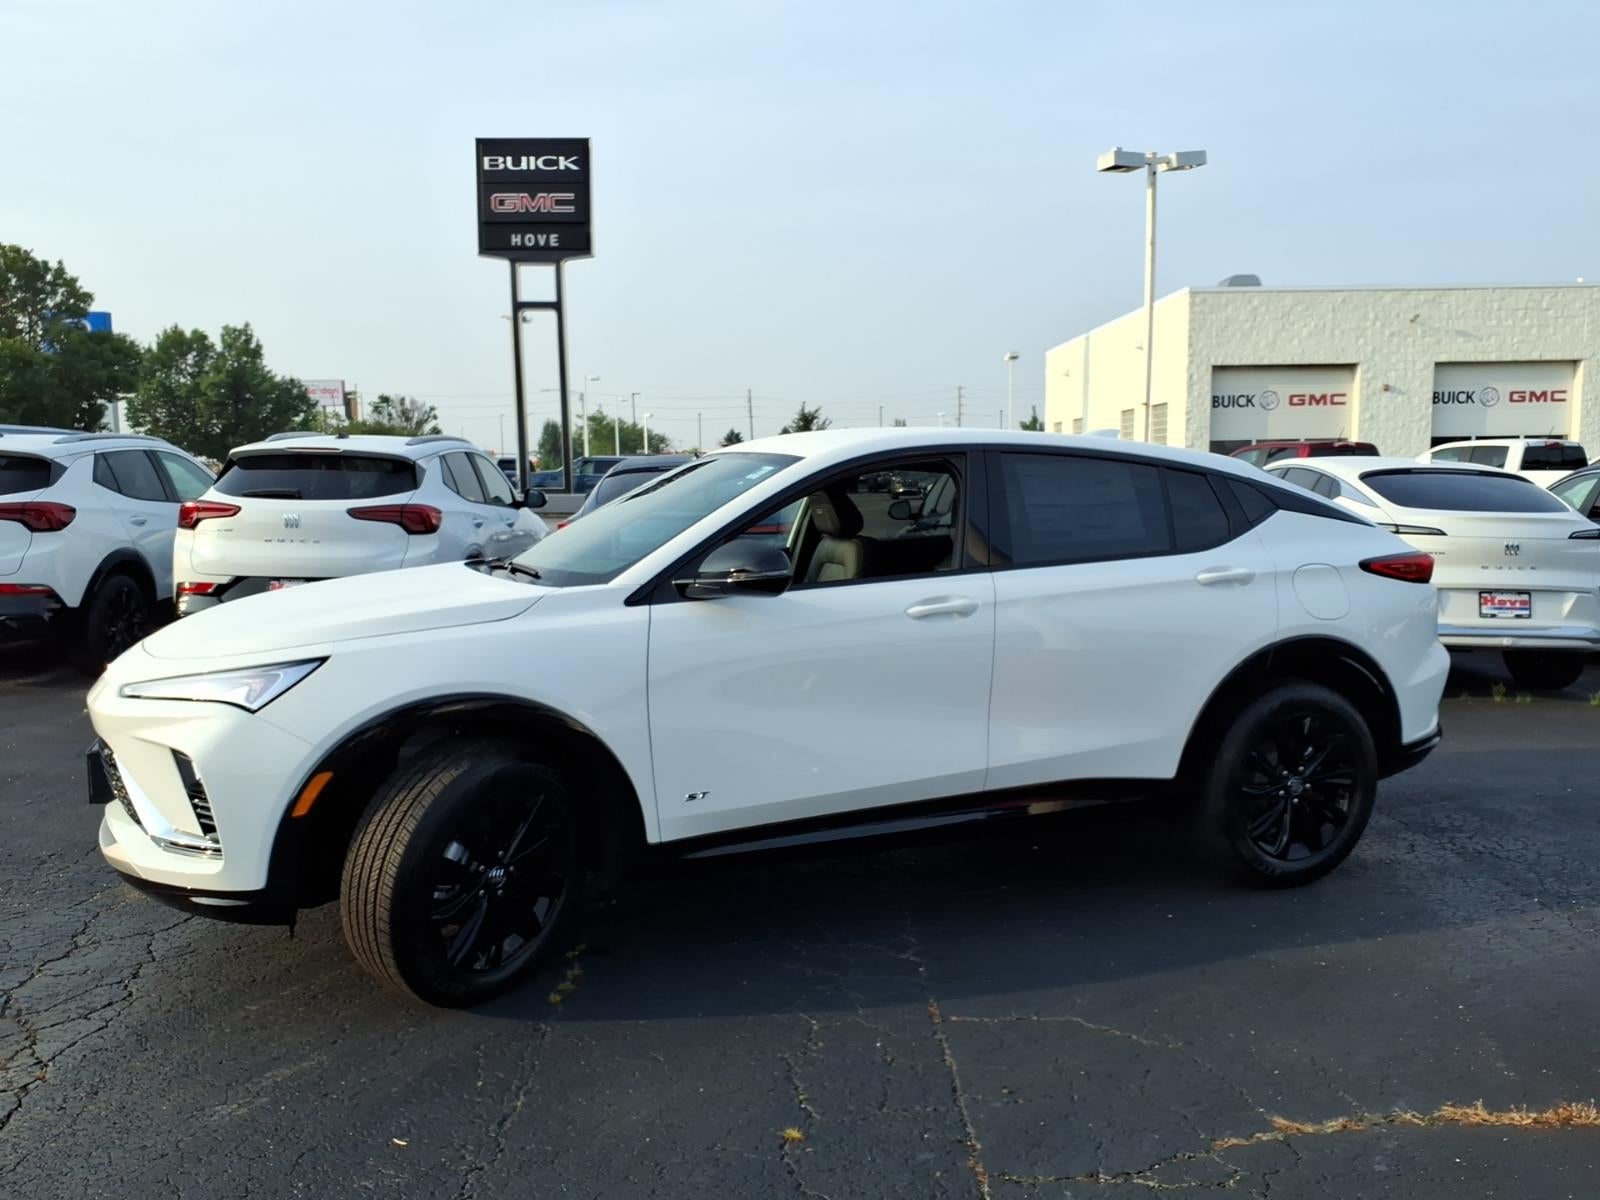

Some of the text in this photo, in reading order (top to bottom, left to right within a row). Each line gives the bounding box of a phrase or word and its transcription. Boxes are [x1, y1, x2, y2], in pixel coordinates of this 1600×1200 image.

[483, 155, 580, 170] BUICK
[490, 193, 576, 213] GMC
[510, 233, 560, 247] HOVE
[1212, 393, 1347, 408] BUICK GMC
[1433, 390, 1567, 405] BUICK GMC
